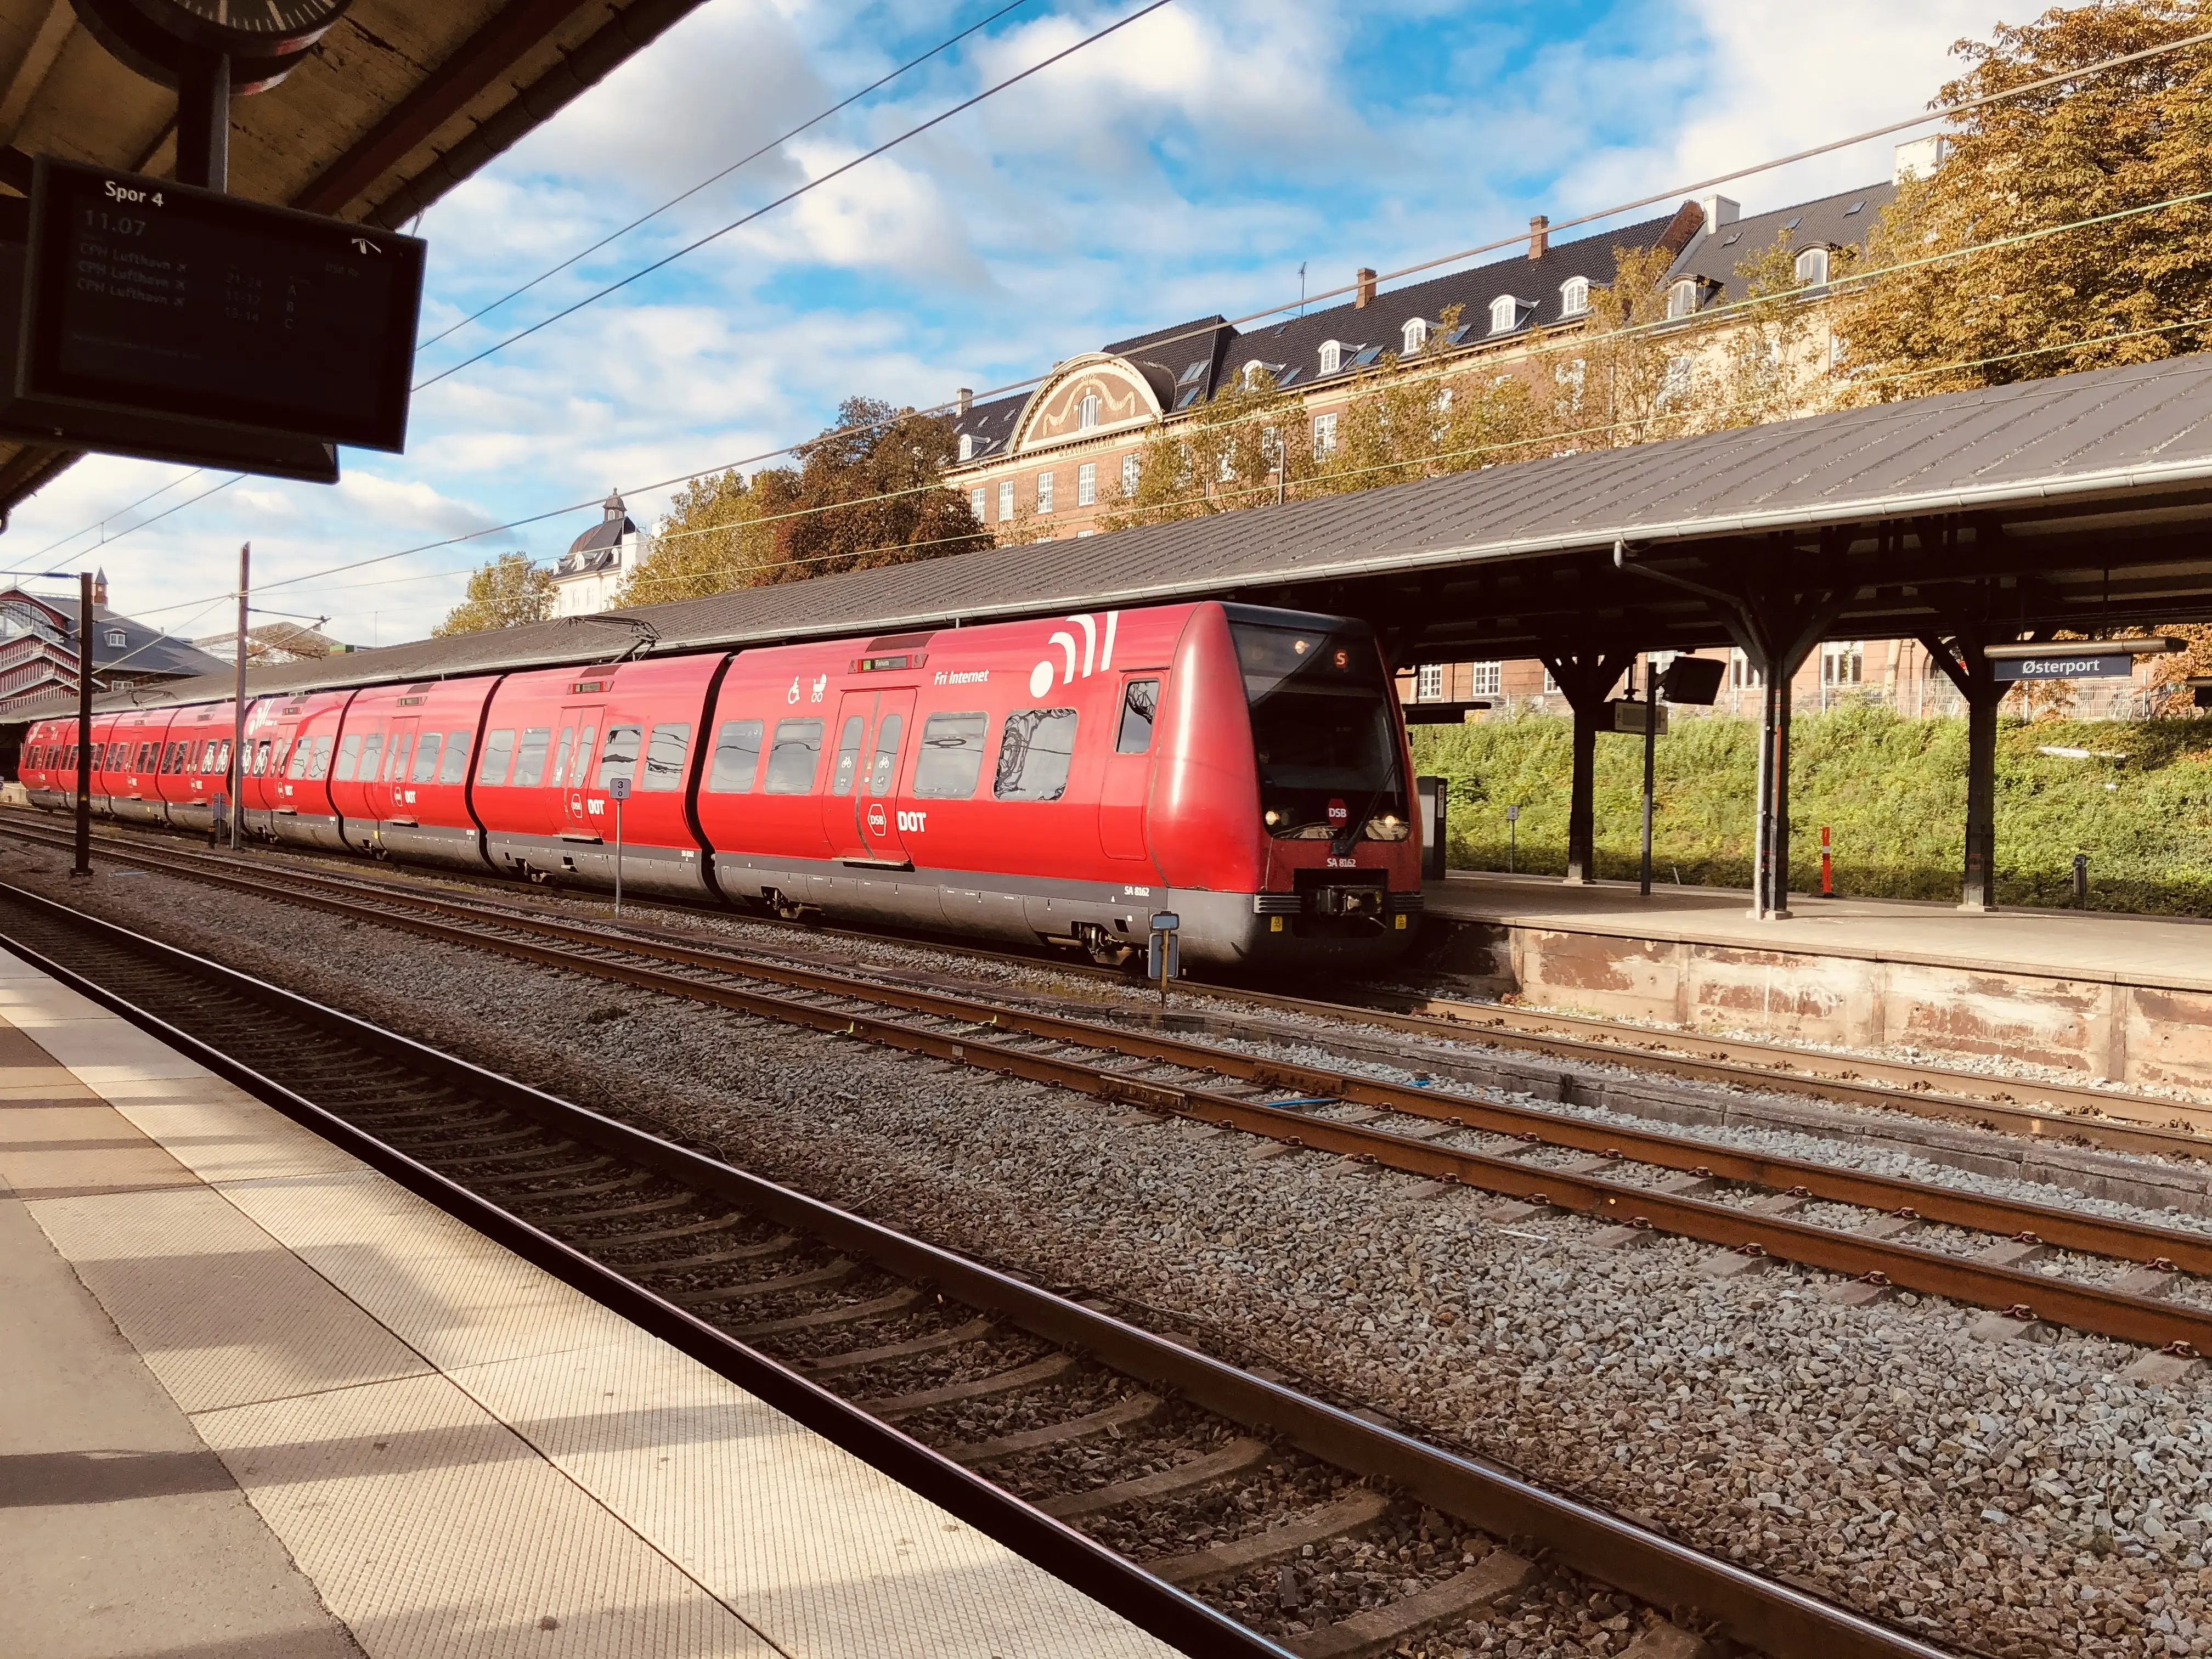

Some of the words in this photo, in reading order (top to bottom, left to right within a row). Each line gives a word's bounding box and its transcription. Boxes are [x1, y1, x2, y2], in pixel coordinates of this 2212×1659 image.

[104, 180, 146, 203] Spor
[151, 192, 164, 207] 4
[85, 209, 147, 236] 11.07
[1336, 652, 1345, 665] S
[2022, 659, 2100, 675] Østerport
[934, 671, 948, 685] Fri
[949, 669, 989, 684] Internet
[404, 791, 416, 804] DOT
[588, 799, 605, 815] DOT
[1329, 808, 1347, 817] DSB
[870, 815, 884, 825] DSB
[898, 811, 927, 832] DOT
[1327, 858, 1338, 867] SA
[1339, 859, 1356, 867] 8162
[1124, 885, 1133, 895] SA
[1135, 887, 1150, 896] 8162
